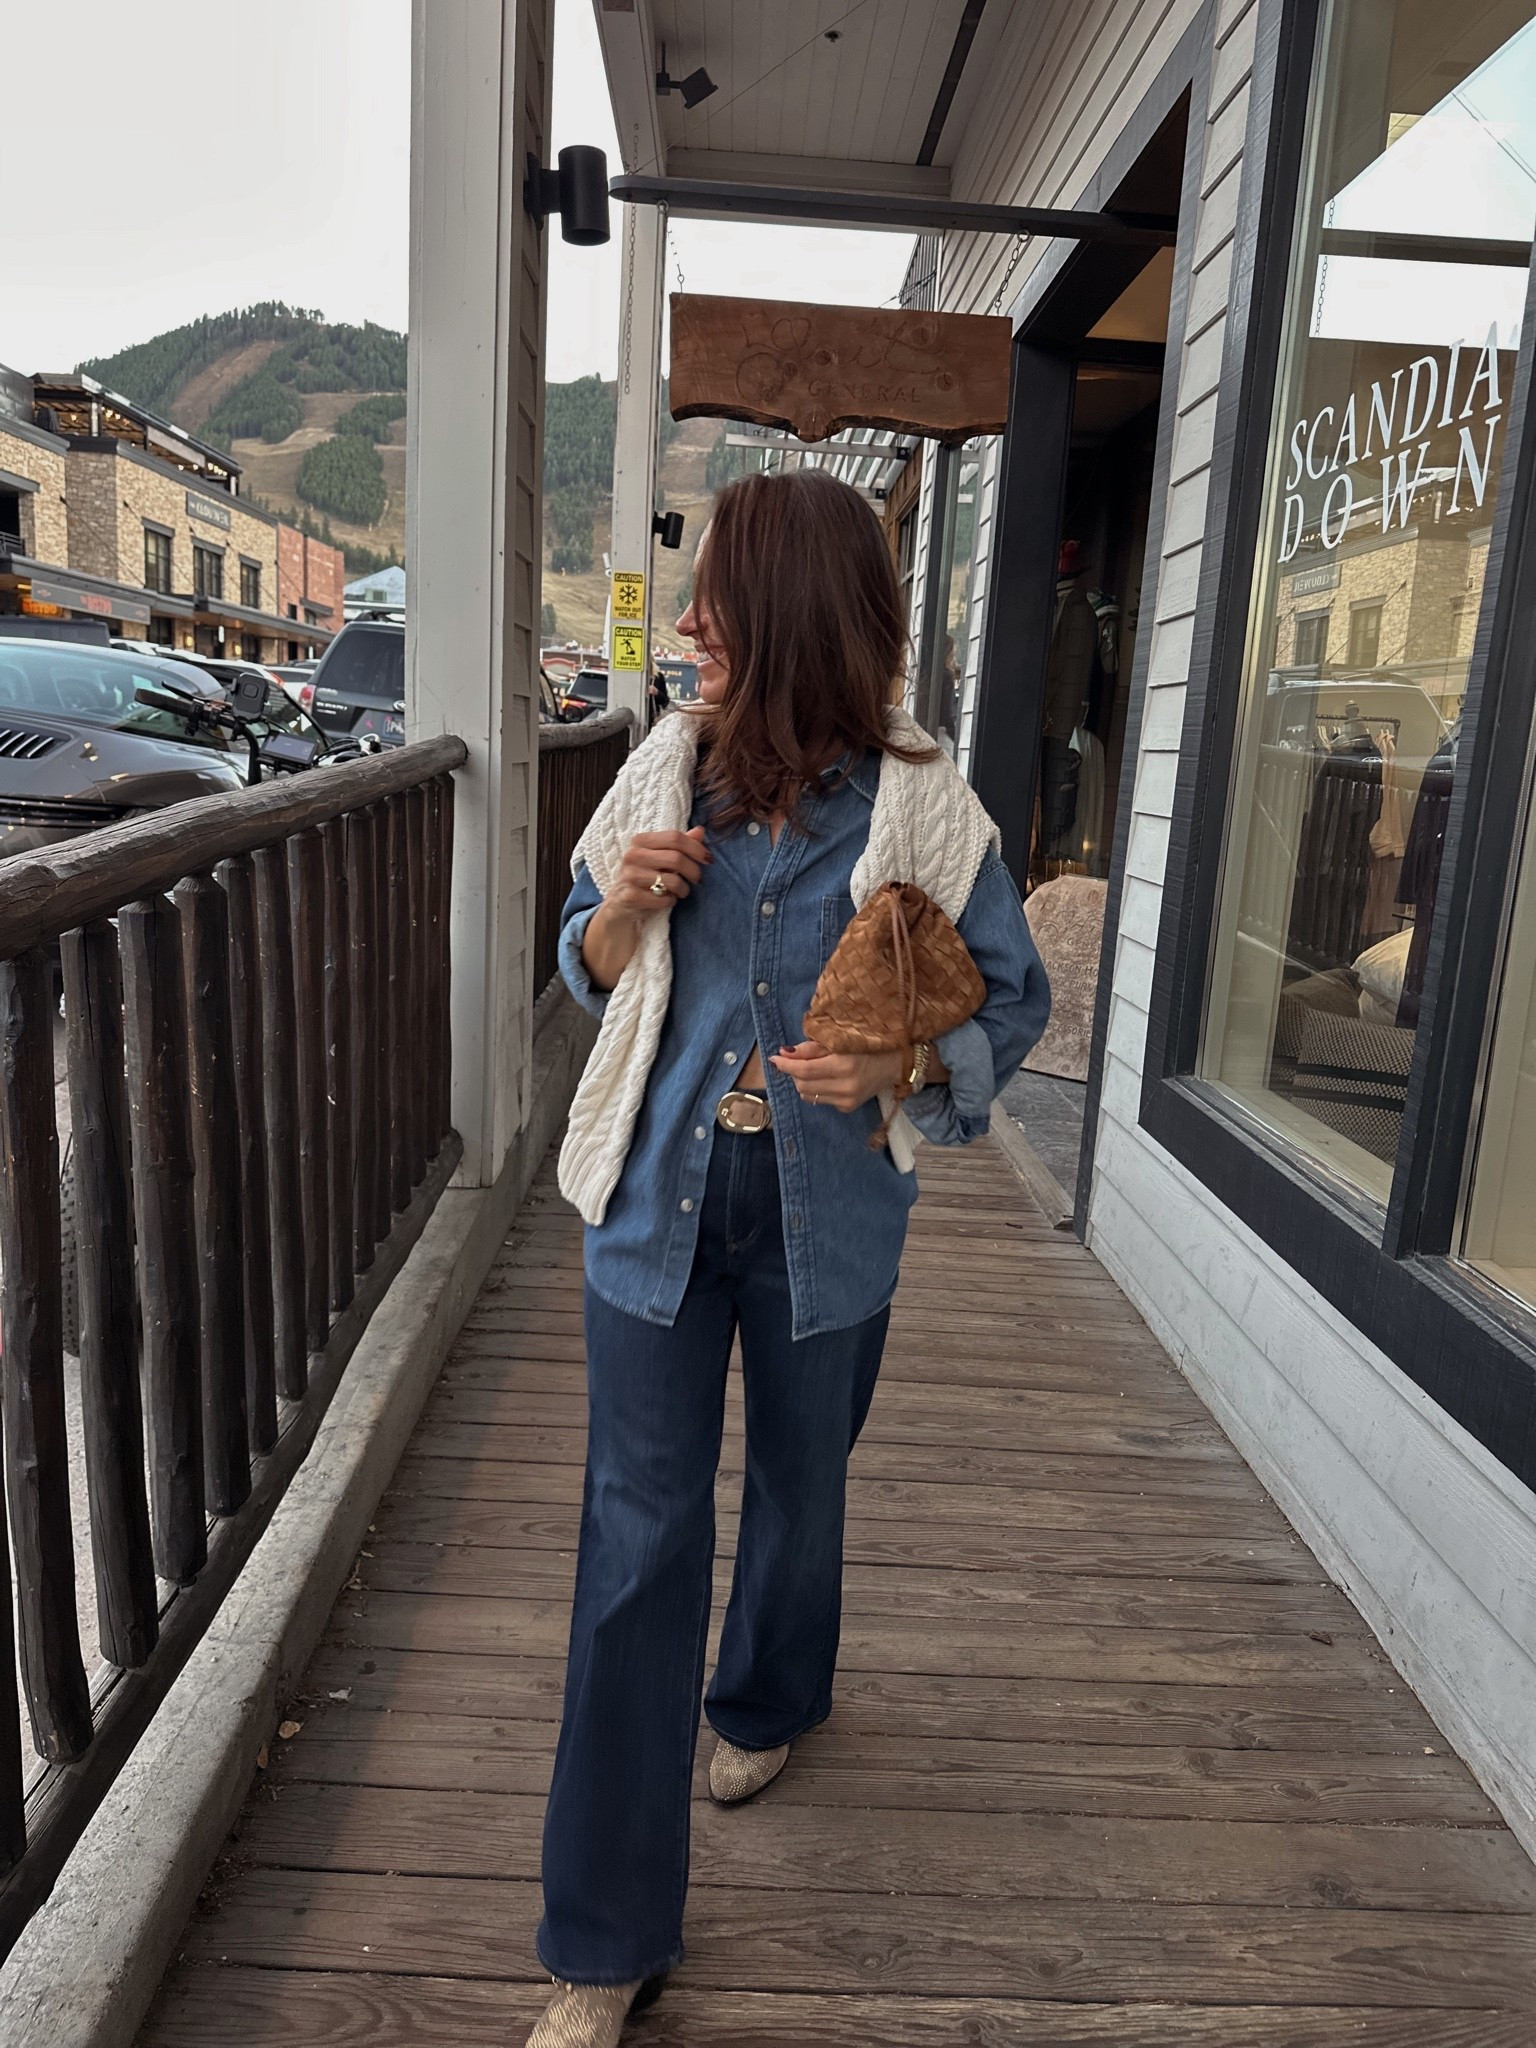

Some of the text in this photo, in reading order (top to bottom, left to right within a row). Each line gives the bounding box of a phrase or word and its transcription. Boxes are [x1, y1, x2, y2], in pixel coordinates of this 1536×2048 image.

[807, 380, 921, 403] GENERAL
[1285, 320, 1503, 492] SCANDIA
[1276, 414, 1502, 565] DOWN
[615, 573, 643, 583] CAUTION
[615, 627, 643, 637] CAUTION
[1045, 960, 1099, 977] ACKSON HO
[1046, 1022, 1092, 1038] CCESSORIE
